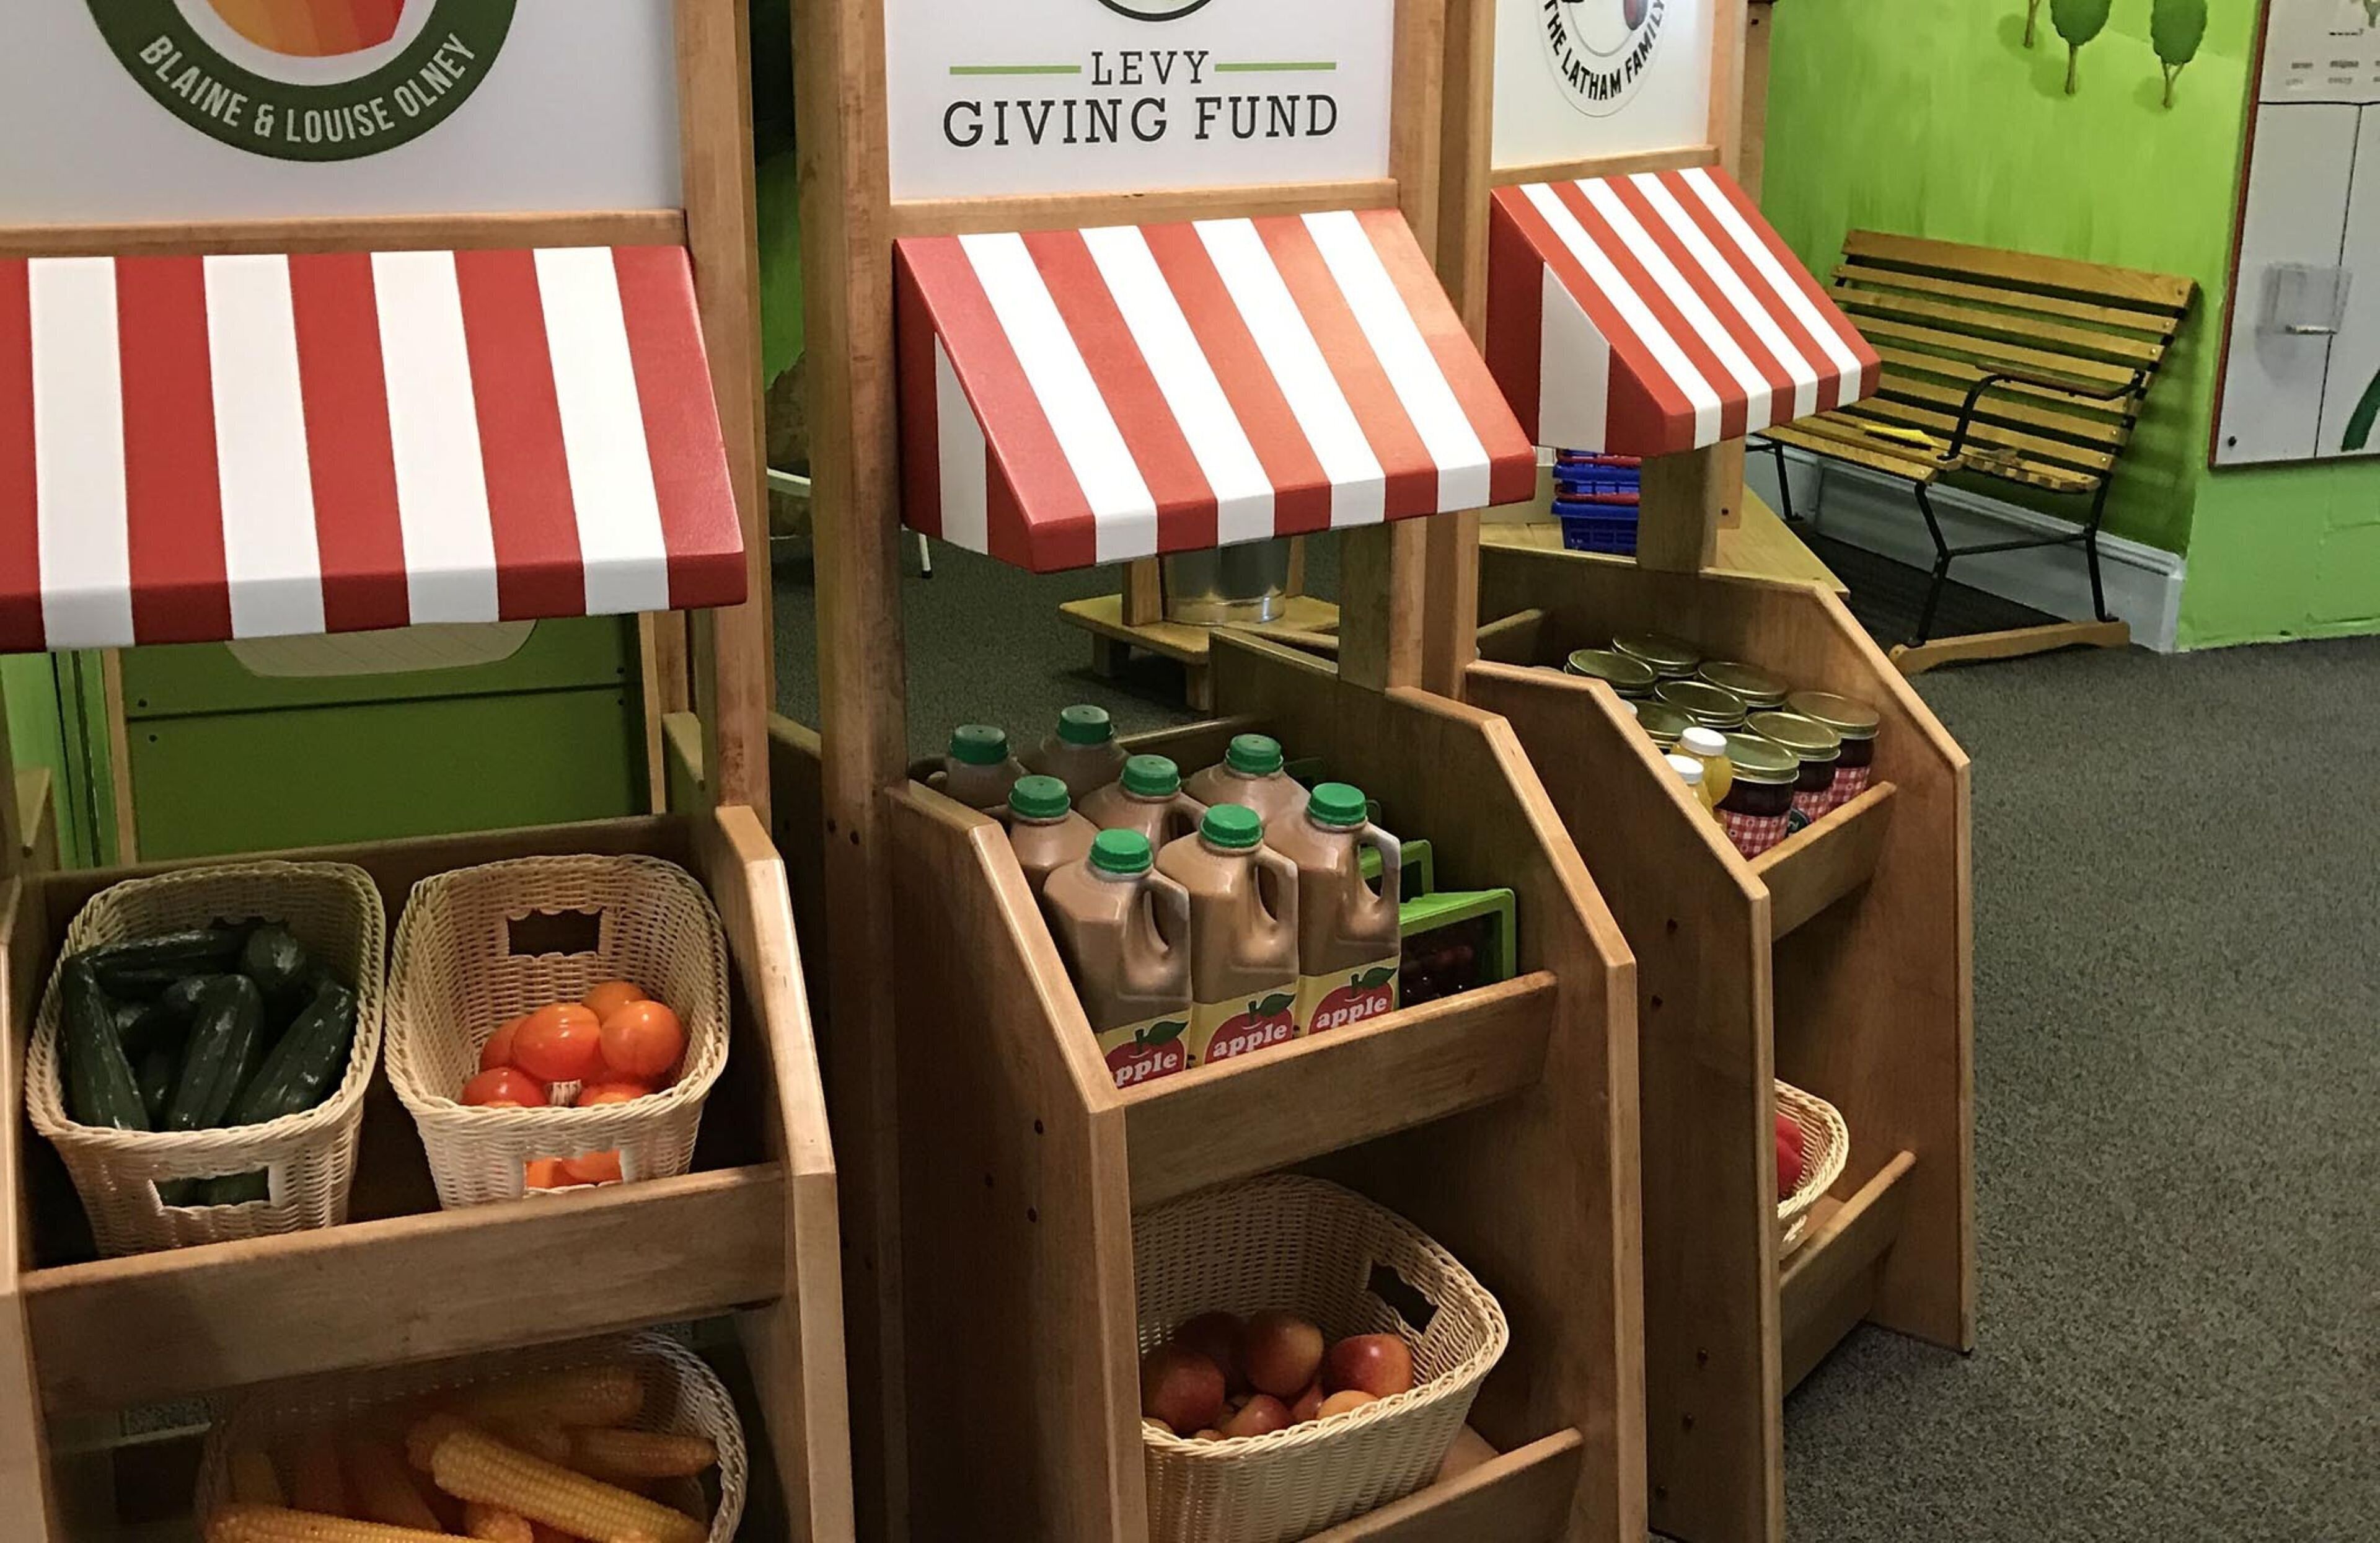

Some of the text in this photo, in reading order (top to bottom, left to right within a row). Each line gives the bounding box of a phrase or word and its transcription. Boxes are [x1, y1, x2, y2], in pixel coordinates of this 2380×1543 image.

[1091, 50, 1209, 85] LEVY
[1561, 48, 1622, 100] LATHAM
[1625, 0, 1665, 84] FAMILY
[139, 32, 475, 143] BLAINE & LOUISE OLNEY
[943, 94, 1338, 147] GIVING FUND
[1315, 996, 1388, 1029] apple
[1212, 1022, 1289, 1058] apple
[1113, 1051, 1178, 1088] pple
